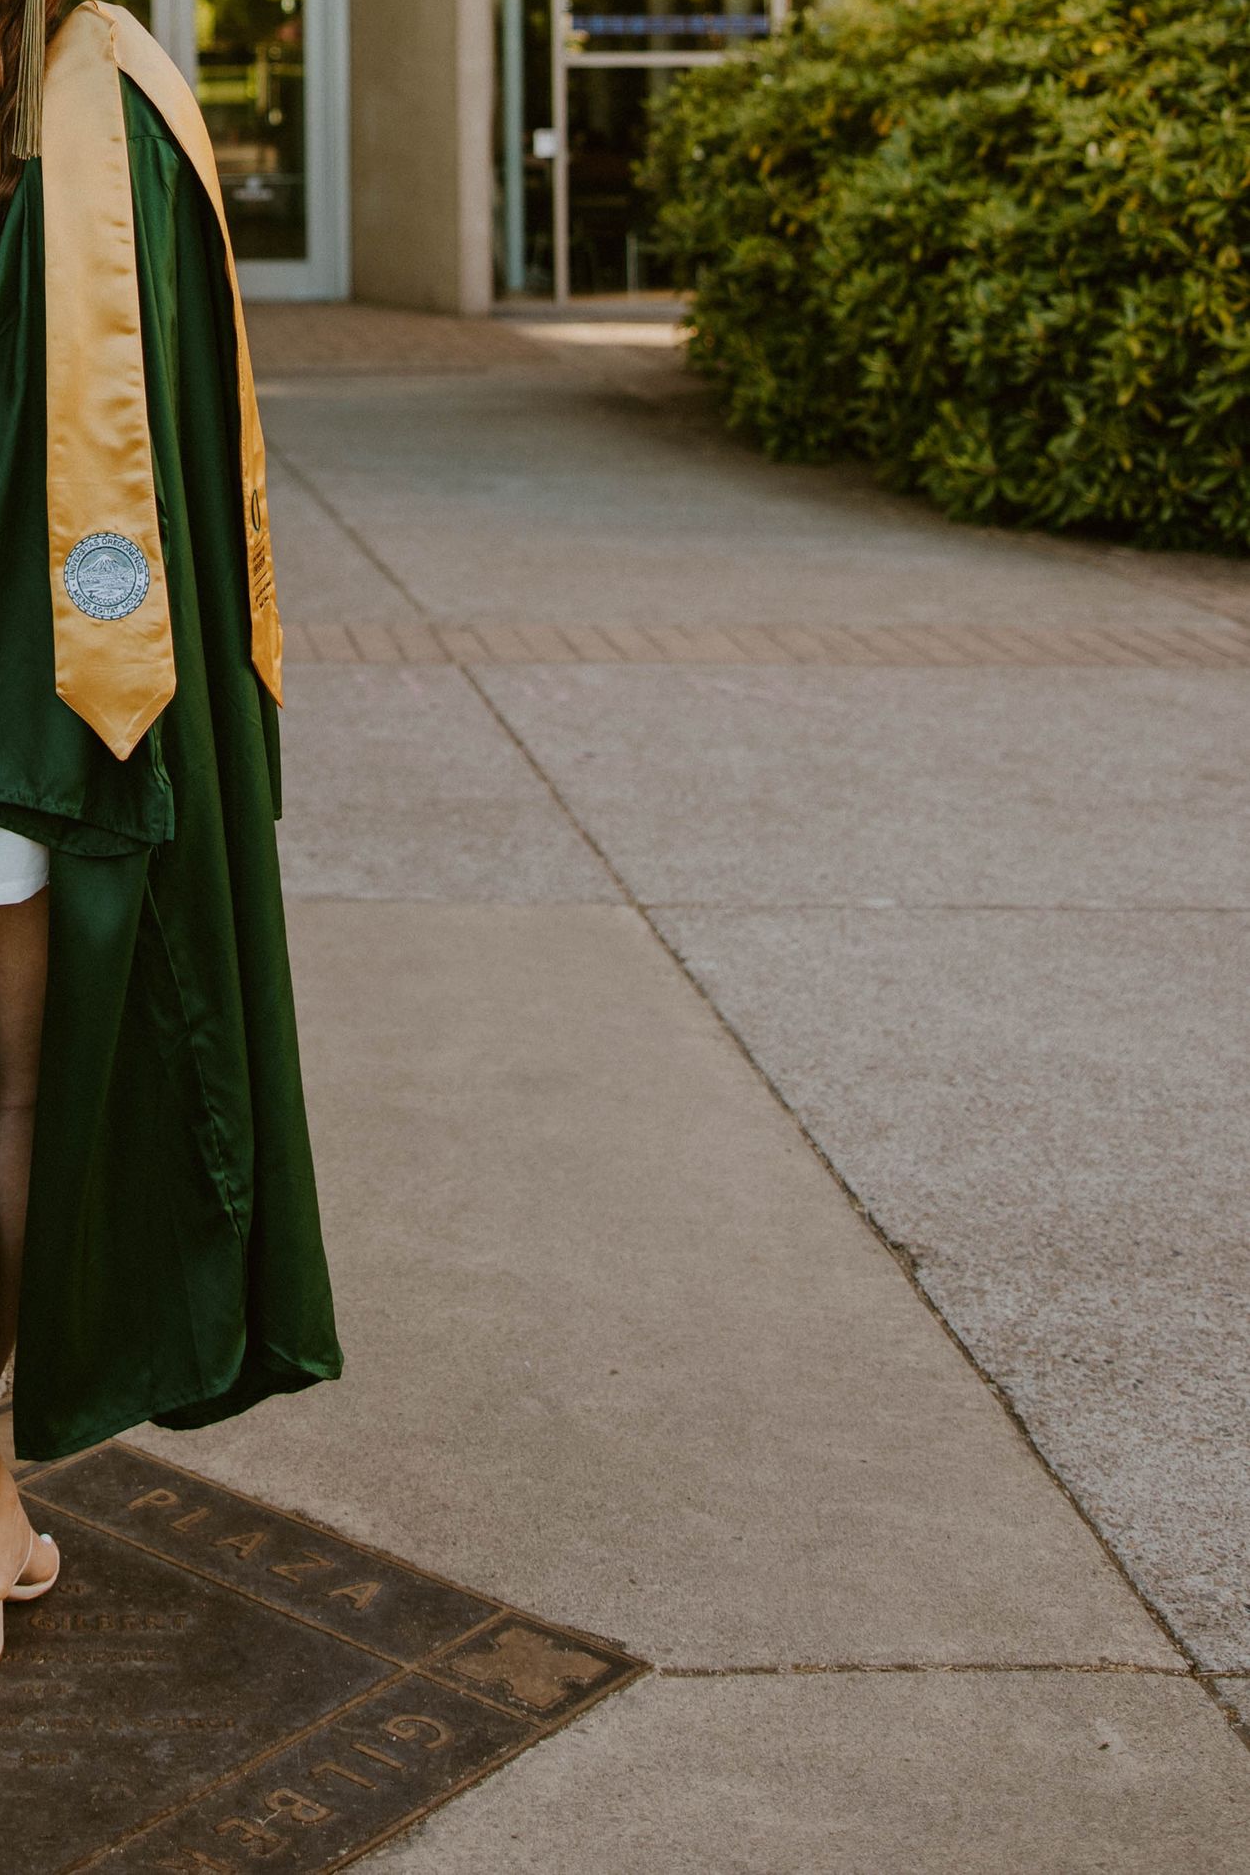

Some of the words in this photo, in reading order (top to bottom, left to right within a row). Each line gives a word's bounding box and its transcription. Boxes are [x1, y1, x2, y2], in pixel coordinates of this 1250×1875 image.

[68, 539, 100, 581] UNIVERSITAS
[101, 538, 145, 575] OREGONENSIS
[73, 589, 91, 609] MENS
[91, 606, 119, 615] AGITAT
[122, 585, 143, 609] MOLEM
[126, 1487, 382, 1611] PLAZA
[30, 1608, 188, 1630] GILBERT
